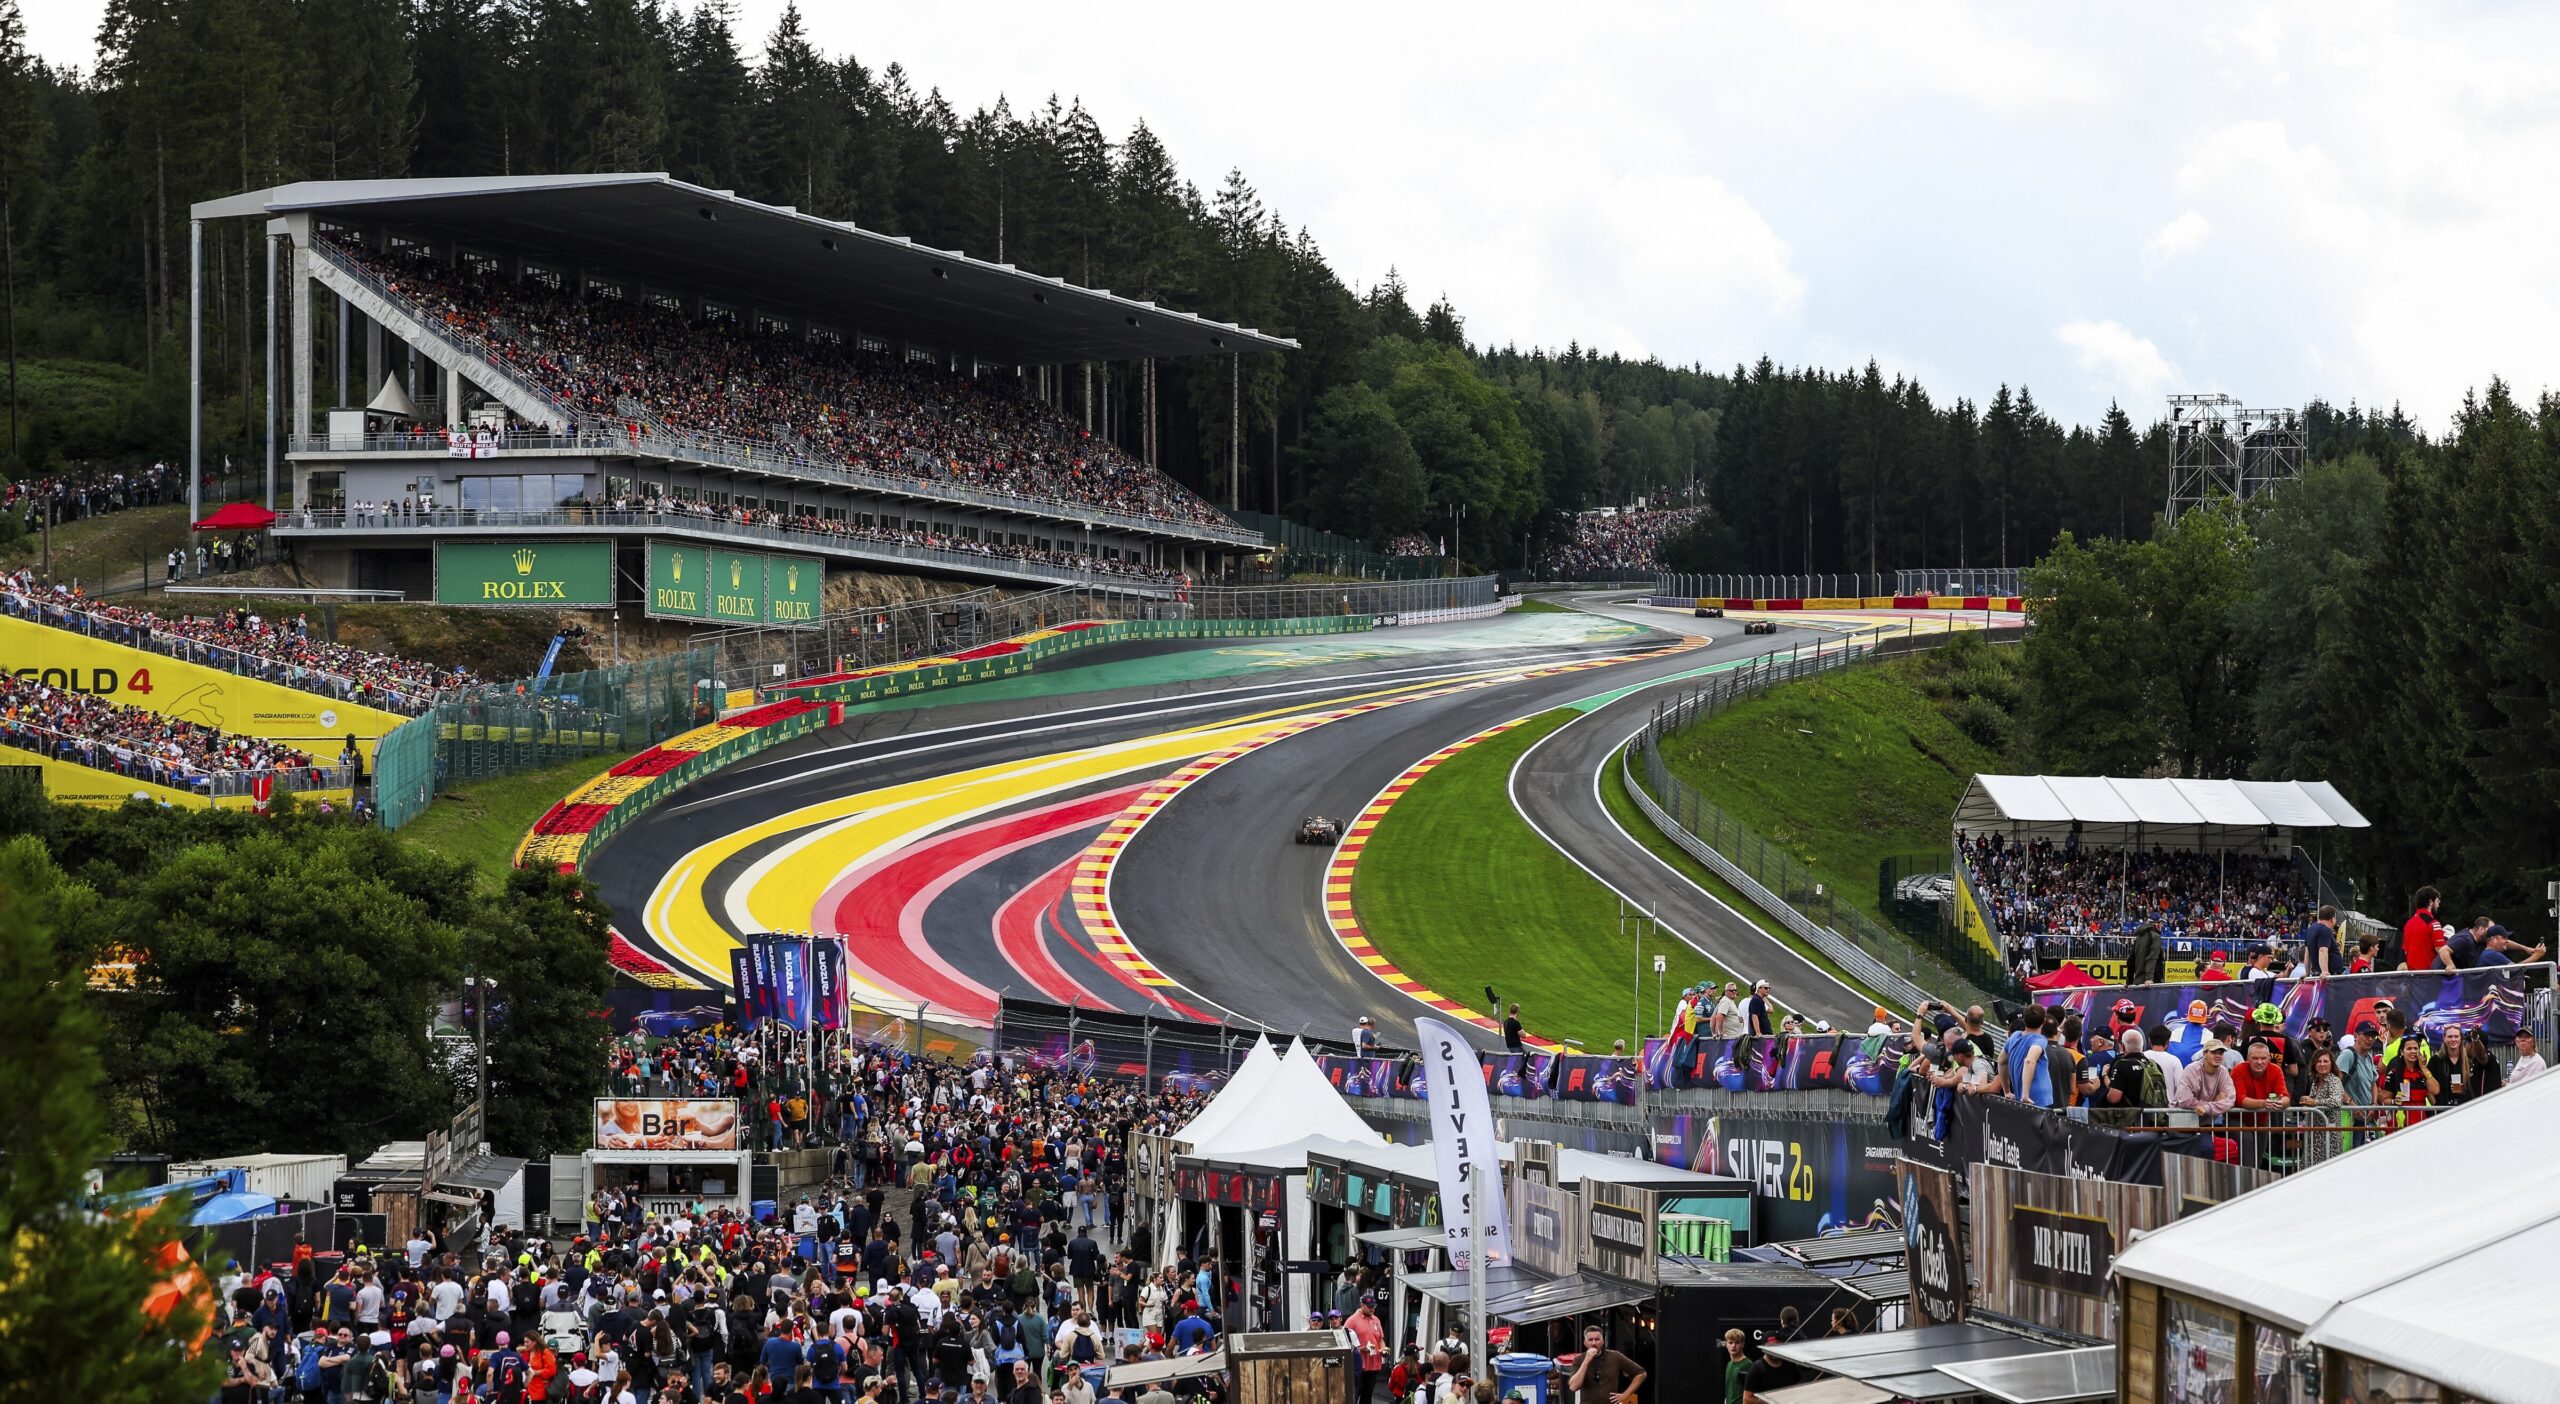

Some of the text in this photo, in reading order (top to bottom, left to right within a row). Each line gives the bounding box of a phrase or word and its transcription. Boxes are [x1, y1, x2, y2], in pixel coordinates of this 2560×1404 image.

[482, 581, 566, 599] ROLEX
[657, 588, 696, 611] ROLEX
[717, 595, 755, 617] ROLEX
[775, 601, 810, 620] ROLEX
[127, 668, 153, 695] 4
[884, 686, 899, 695] ROLEX
[908, 681, 924, 690] ROLEX
[932, 677, 948, 686] ROLEX
[860, 690, 876, 699] ROLEX
[2181, 943, 2189, 951] A
[643, 1114, 690, 1136] Bar
[1983, 1108, 2021, 1169] United Taste
[1728, 1138, 1784, 1199] SILVER
[1592, 1211, 1644, 1248] STEAKHOUSE BURGER
[839, 1247, 853, 1255] 33
[1917, 1223, 1949, 1292] Tickets
[2034, 1226, 2091, 1276] MR PITTA
[1378, 1291, 1390, 1300] 07
